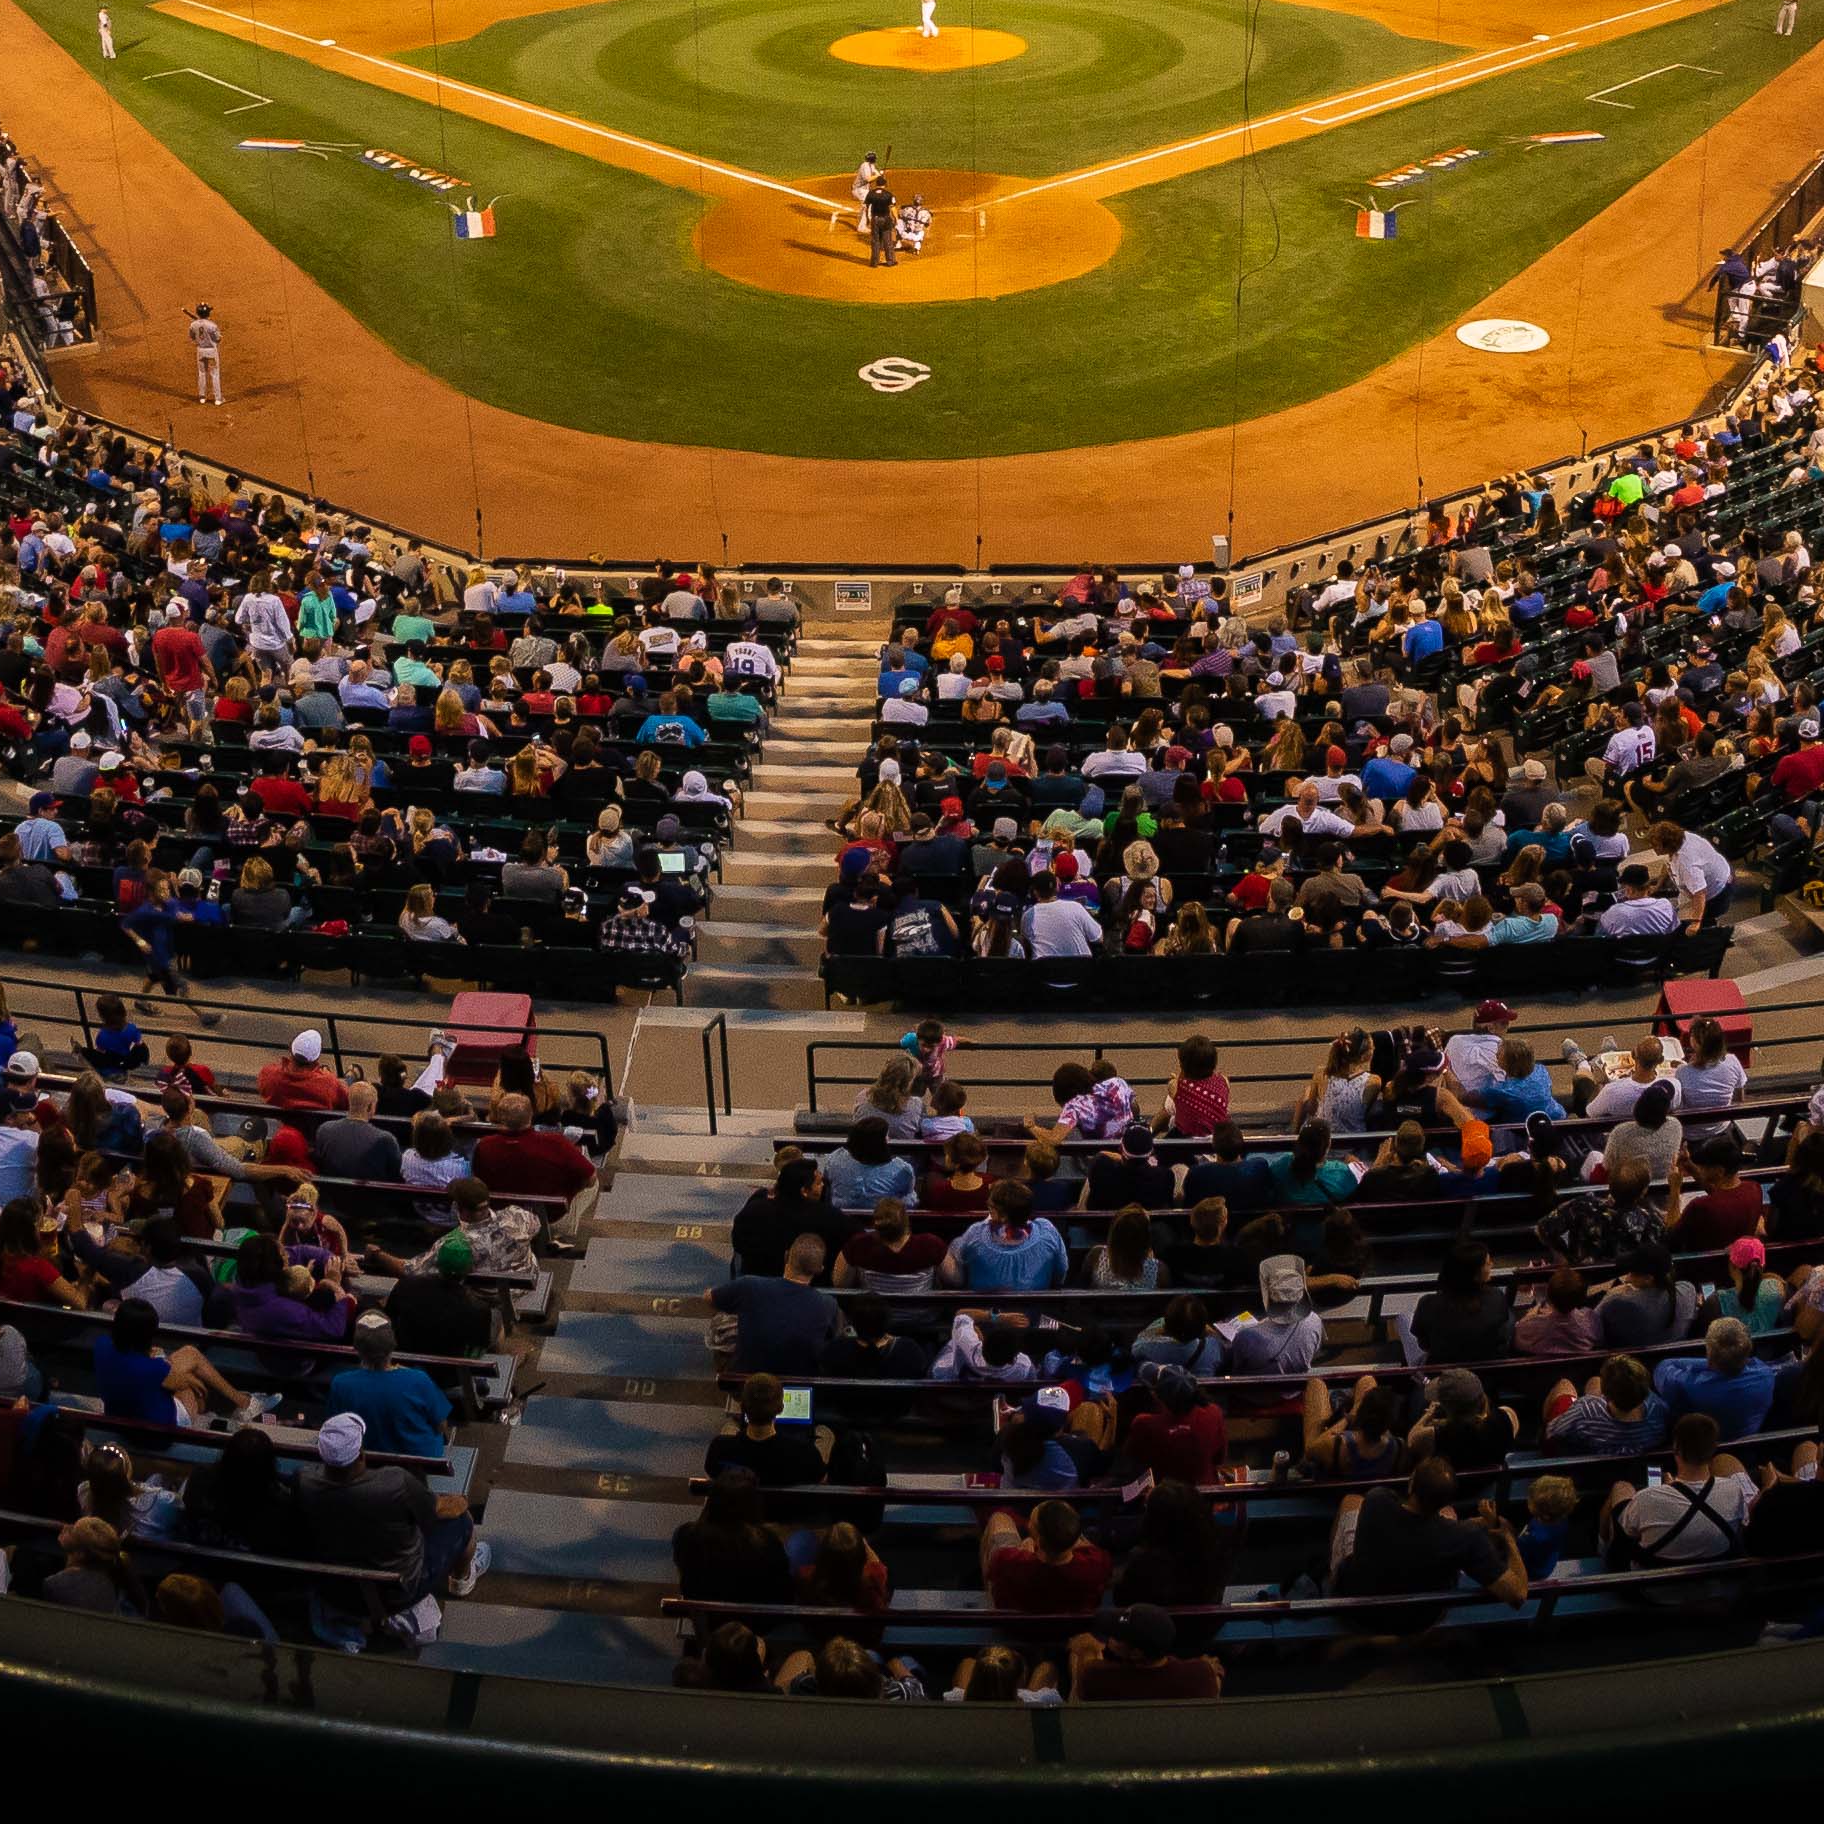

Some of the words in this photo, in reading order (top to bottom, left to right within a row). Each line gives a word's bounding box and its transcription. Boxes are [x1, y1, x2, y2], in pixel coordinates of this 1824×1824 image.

[1635, 742, 1653, 766] 15
[695, 1162, 721, 1176] AA
[675, 1224, 703, 1239] BB
[624, 1379, 655, 1396] DD
